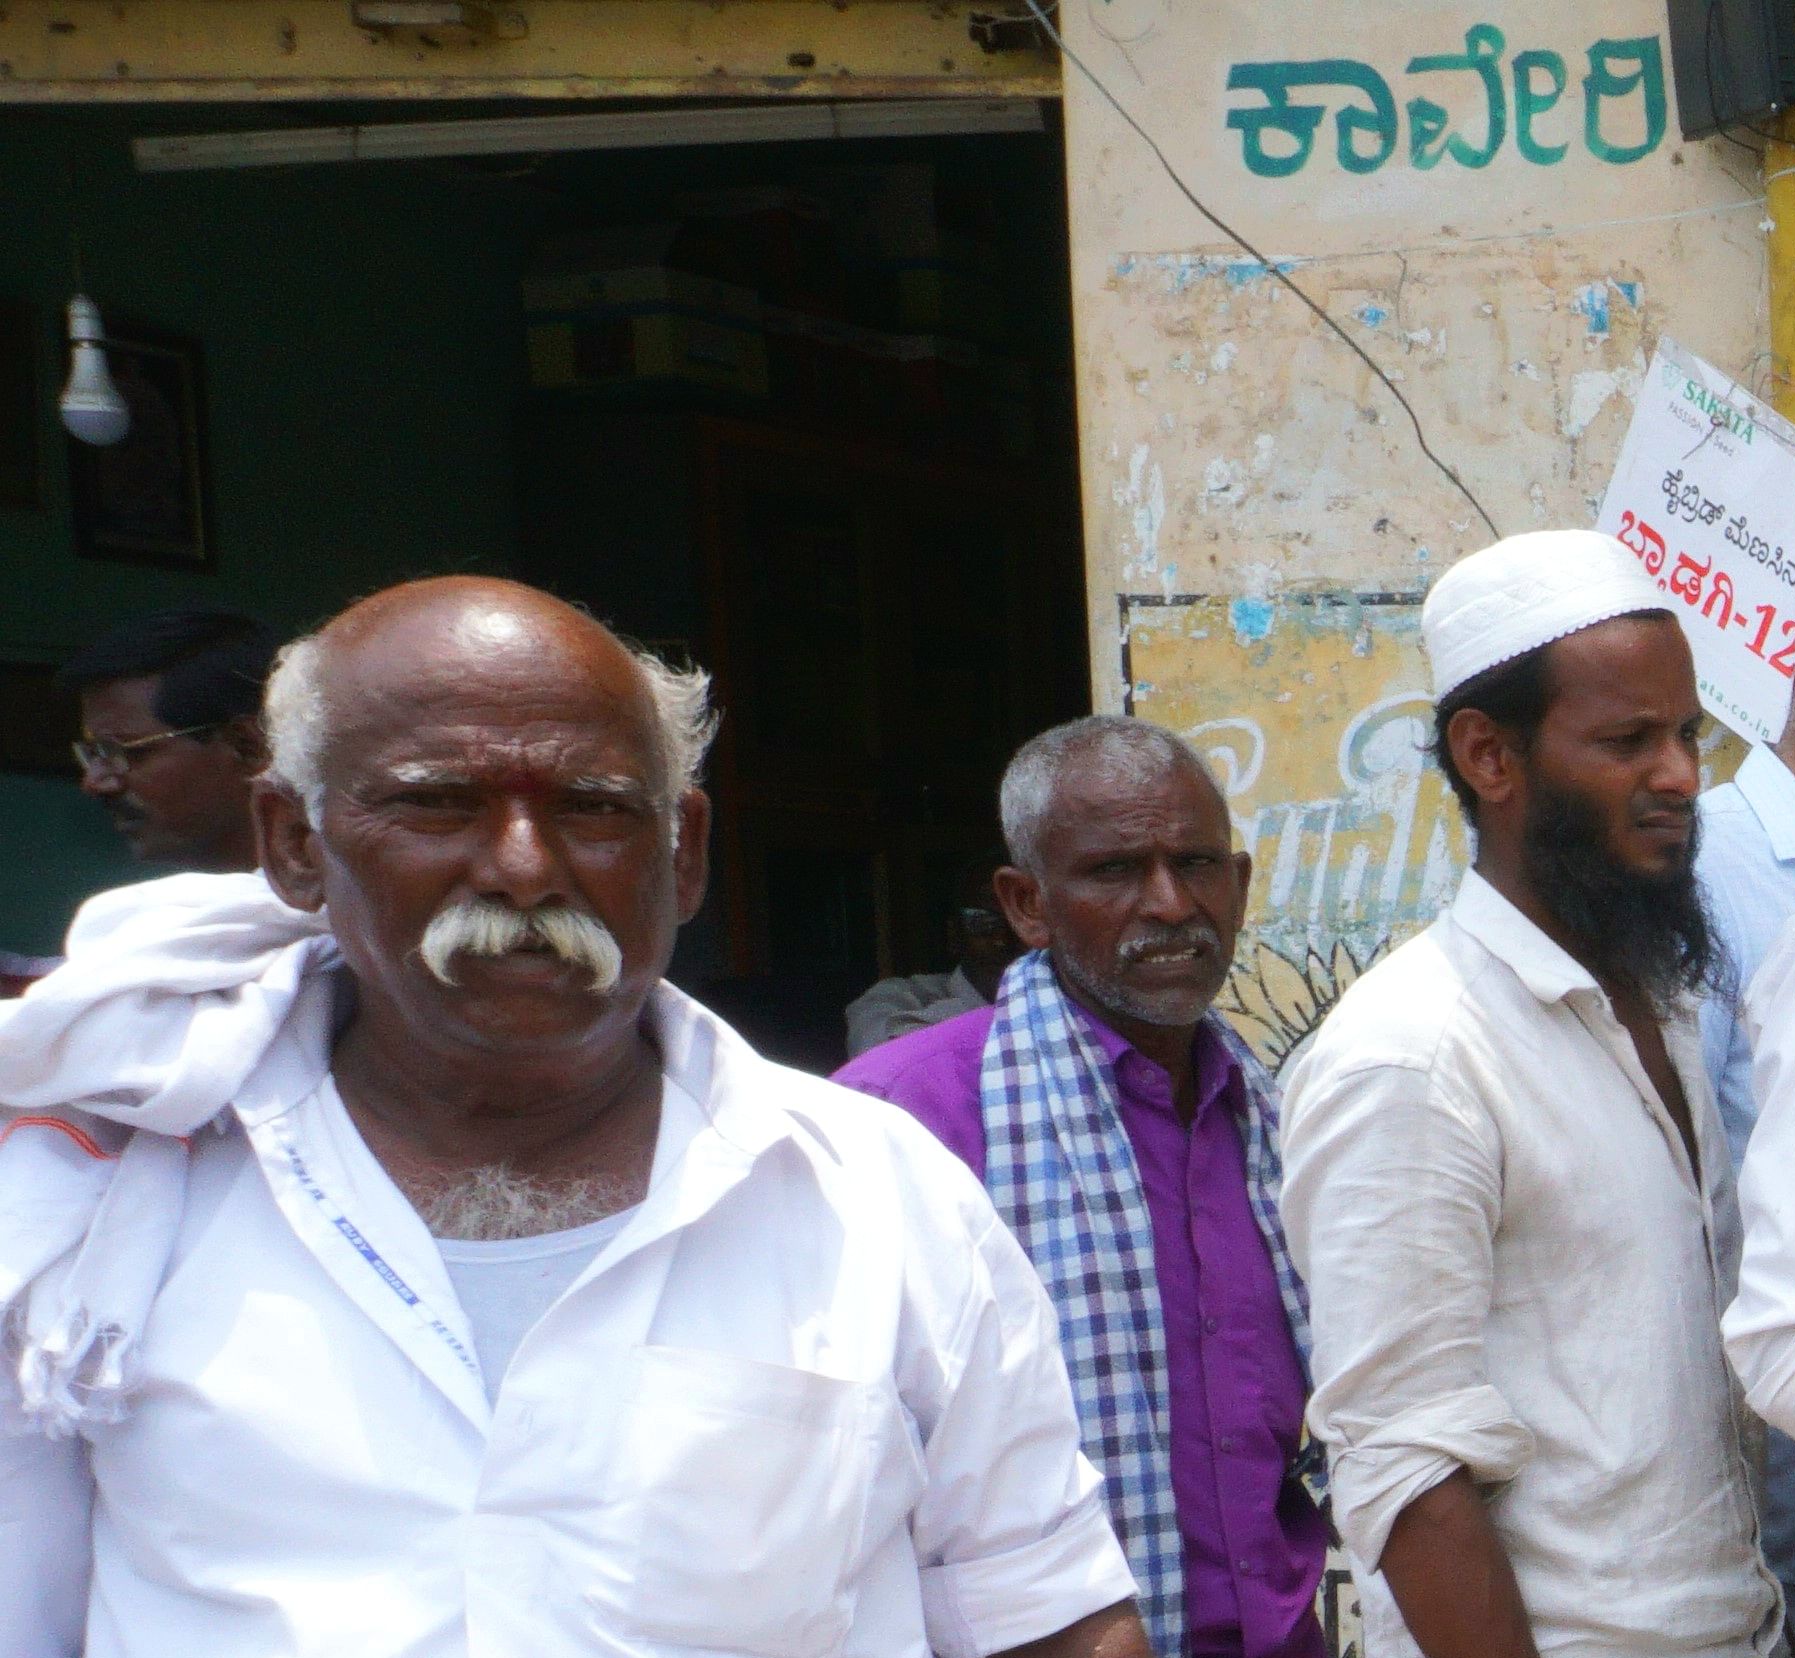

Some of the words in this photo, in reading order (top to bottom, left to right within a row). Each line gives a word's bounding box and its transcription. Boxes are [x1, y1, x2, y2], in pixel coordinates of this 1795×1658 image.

[1225, 22, 1669, 179] ಕಾವೇರಿ
[1682, 378, 1757, 446] SAKATA
[1661, 467, 1726, 525] ಹೈಬ್ರಿಡ್
[1698, 678, 1772, 740] ata.co.in
